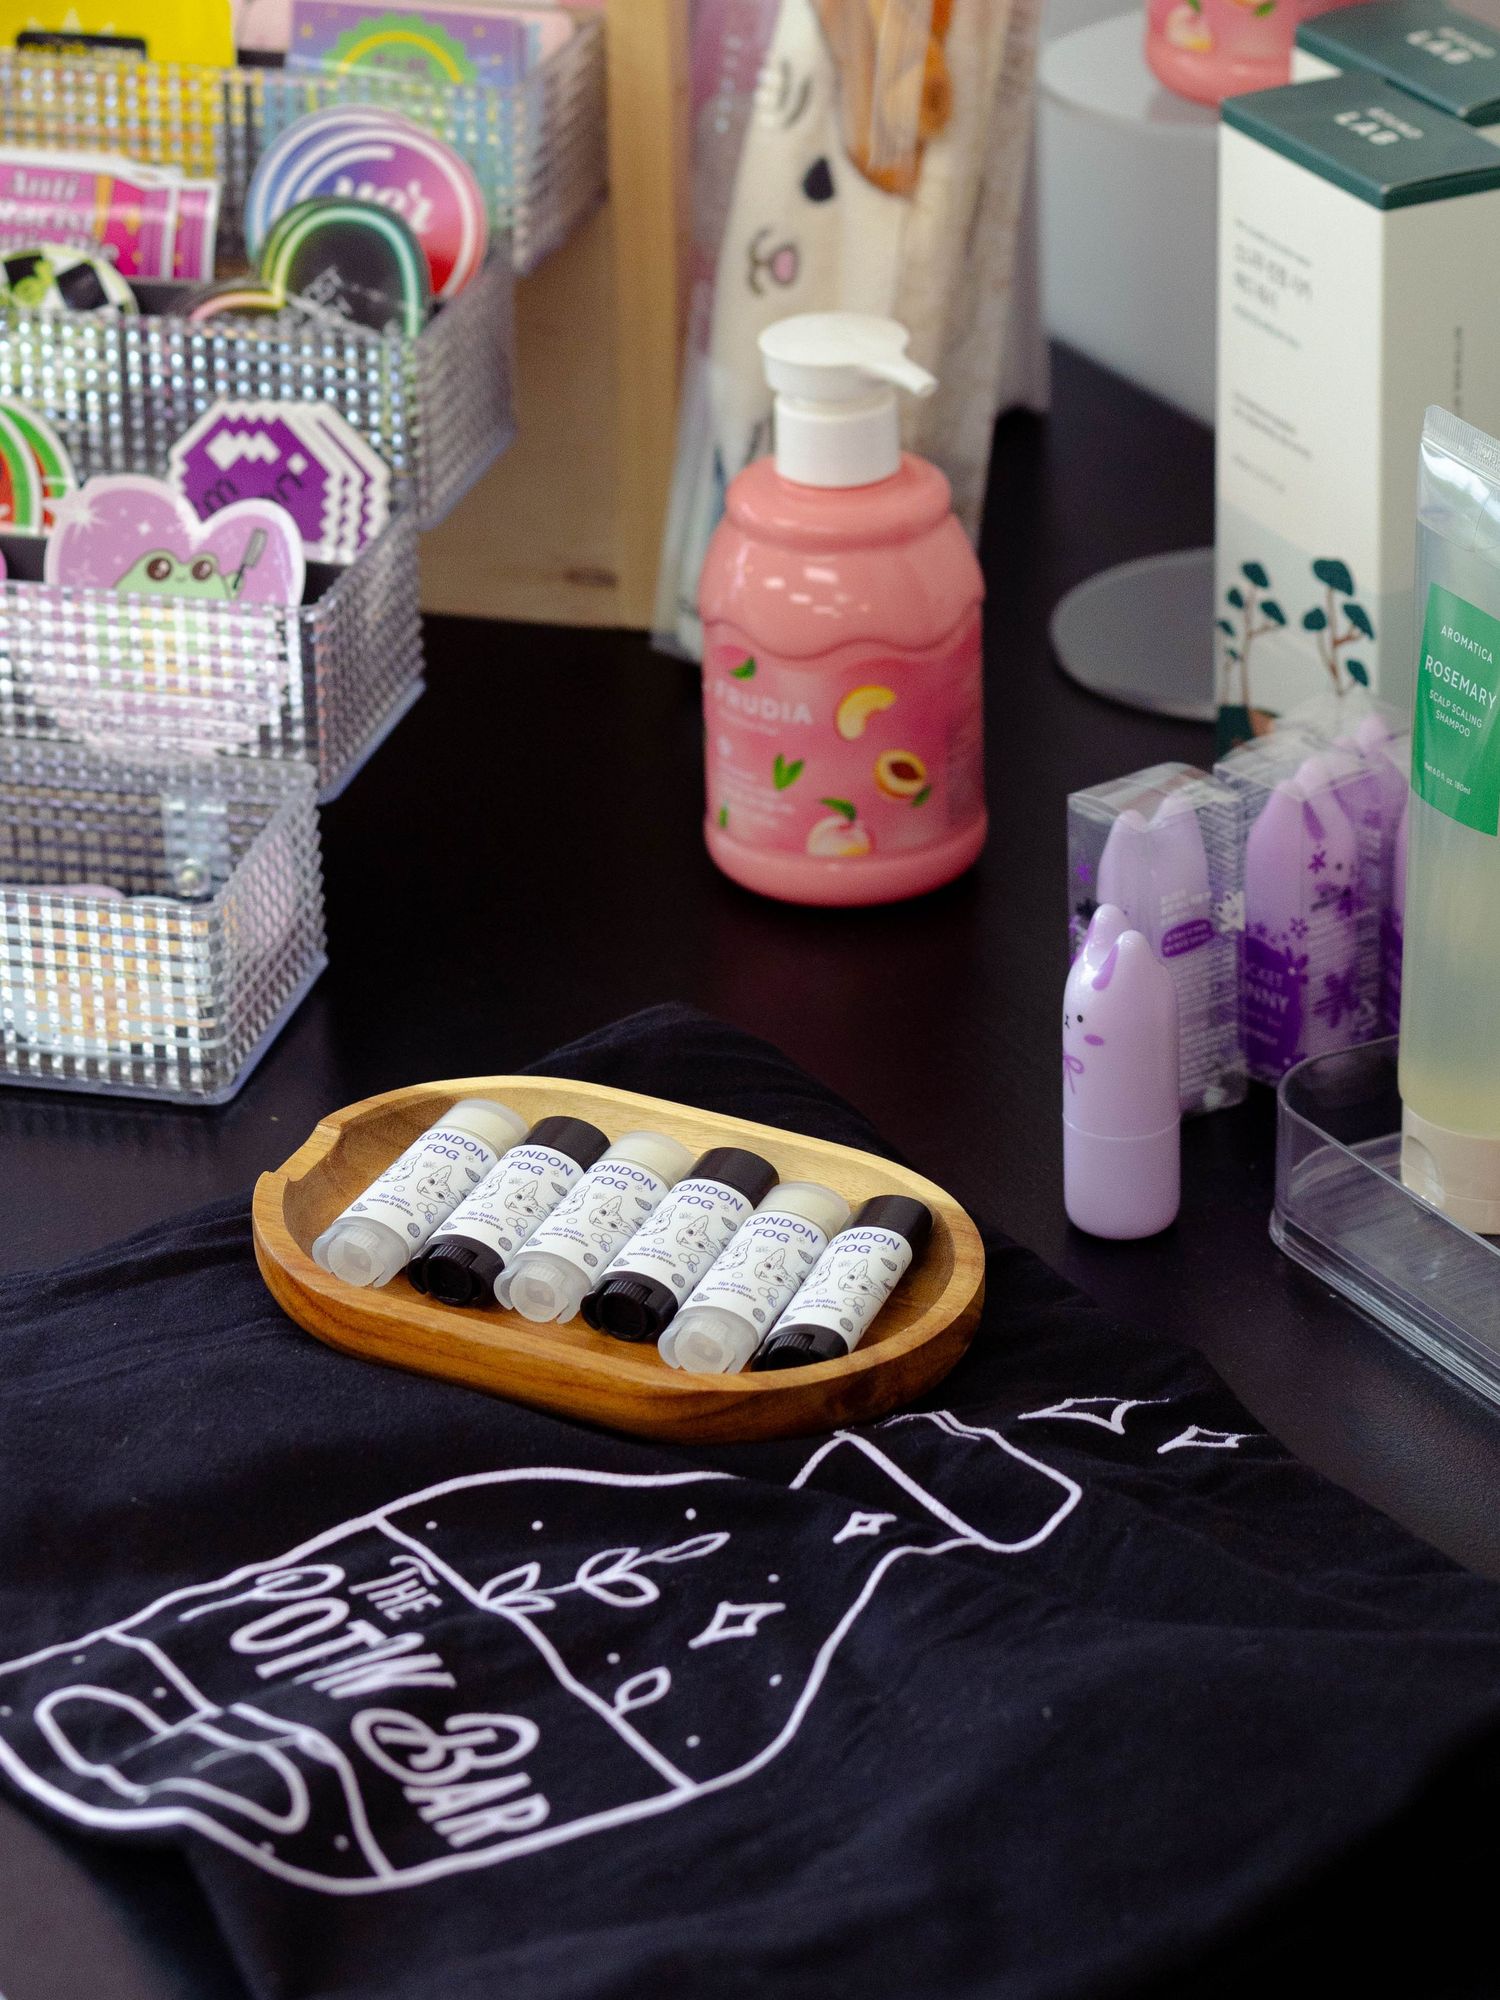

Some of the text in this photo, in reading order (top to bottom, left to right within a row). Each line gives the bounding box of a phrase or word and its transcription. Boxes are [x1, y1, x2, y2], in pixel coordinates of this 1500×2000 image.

[1441, 625, 1493, 664] AROMATICA
[1425, 654, 1497, 710] ROSEMARY
[1429, 689, 1482, 728] SCALP SCALING
[1435, 709, 1471, 737] SHAMPOO
[419, 1132, 489, 1162] LONDON
[424, 1143, 460, 1161] FOG
[504, 1150, 574, 1176] LONDON
[508, 1161, 545, 1176] FOG
[586, 1164, 658, 1192] LONDON
[592, 1175, 629, 1191] FOG
[391, 1194, 411, 1207] balm
[672, 1183, 744, 1212] LONDON
[678, 1195, 715, 1210] FOG
[480, 1211, 500, 1222] balm
[564, 1227, 585, 1238] balm
[745, 1216, 819, 1244] LONDON
[753, 1228, 790, 1244] FOG
[829, 1231, 900, 1250] LONDON
[835, 1244, 872, 1255] FOG
[349, 1554, 443, 1621] THE
[351, 1708, 550, 1848] BAR
